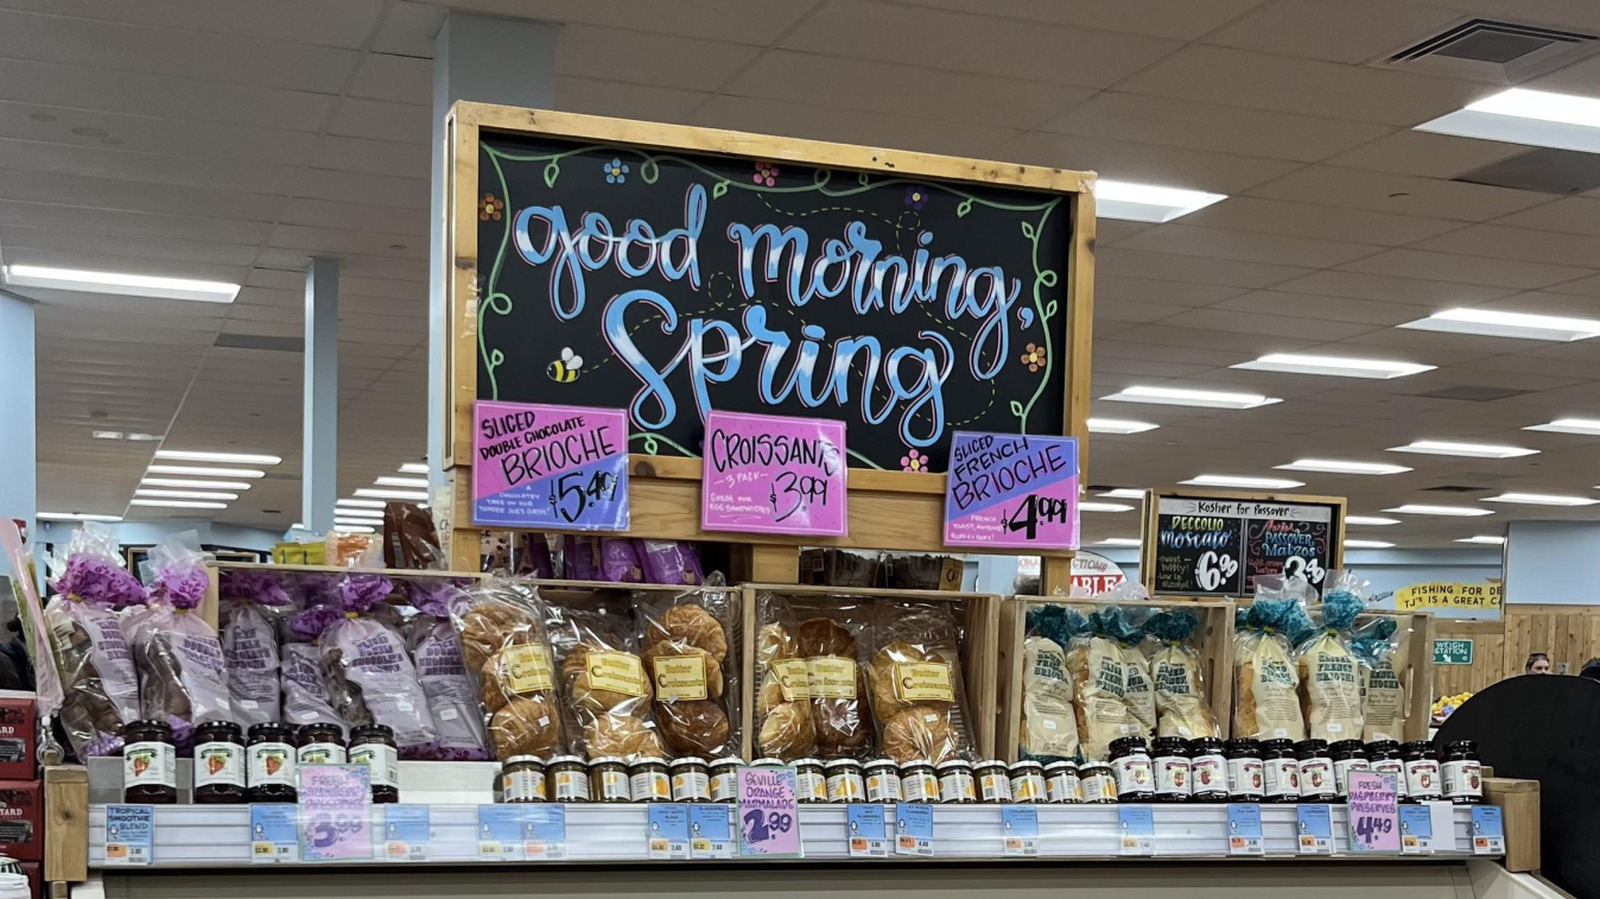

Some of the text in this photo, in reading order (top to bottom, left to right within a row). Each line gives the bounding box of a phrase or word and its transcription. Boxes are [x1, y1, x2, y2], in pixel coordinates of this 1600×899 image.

[514, 183, 1035, 380] good morning,
[602, 288, 955, 448] Spring
[481, 411, 536, 439] SLICED
[480, 416, 586, 461] DOUBLE CHOCOLATE
[500, 426, 617, 486] BRIOCHE
[953, 435, 994, 462] SLICED
[954, 437, 1029, 482] FRENCH
[725, 471, 760, 488] 3 PACK
[952, 445, 1067, 510] BRIOCHE
[548, 469, 618, 523] $5.49
[769, 471, 828, 523] $3.99
[508, 507, 525, 515] JOE'S
[709, 503, 771, 515] EGG SANDWICHES
[1001, 494, 1067, 540] $4.99
[1198, 501, 1290, 517] Kosher for Passover
[1264, 529, 1314, 546] PASSOVER
[1262, 543, 1316, 556] Matzos
[1198, 550, 1238, 591] 6.99
[1411, 585, 1453, 597] FISHING
[1462, 586, 1482, 595] FOR
[1429, 595, 1438, 604] IS
[1442, 595, 1449, 604] A
[1453, 596, 1485, 605] GREAT
[1434, 647, 1467, 655] STATION
[745, 771, 783, 785] SEVILLE
[1358, 780, 1382, 790] FRESH
[746, 786, 785, 798] ORANGE
[1349, 790, 1397, 802] RASPBERRY
[738, 799, 794, 809] MARMALADE
[1352, 801, 1396, 814] PRESERVES
[108, 814, 151, 822] SMOOTHIE
[120, 822, 148, 830] BLEND
[743, 808, 793, 844] 2.99
[1356, 816, 1392, 844] 4.49
